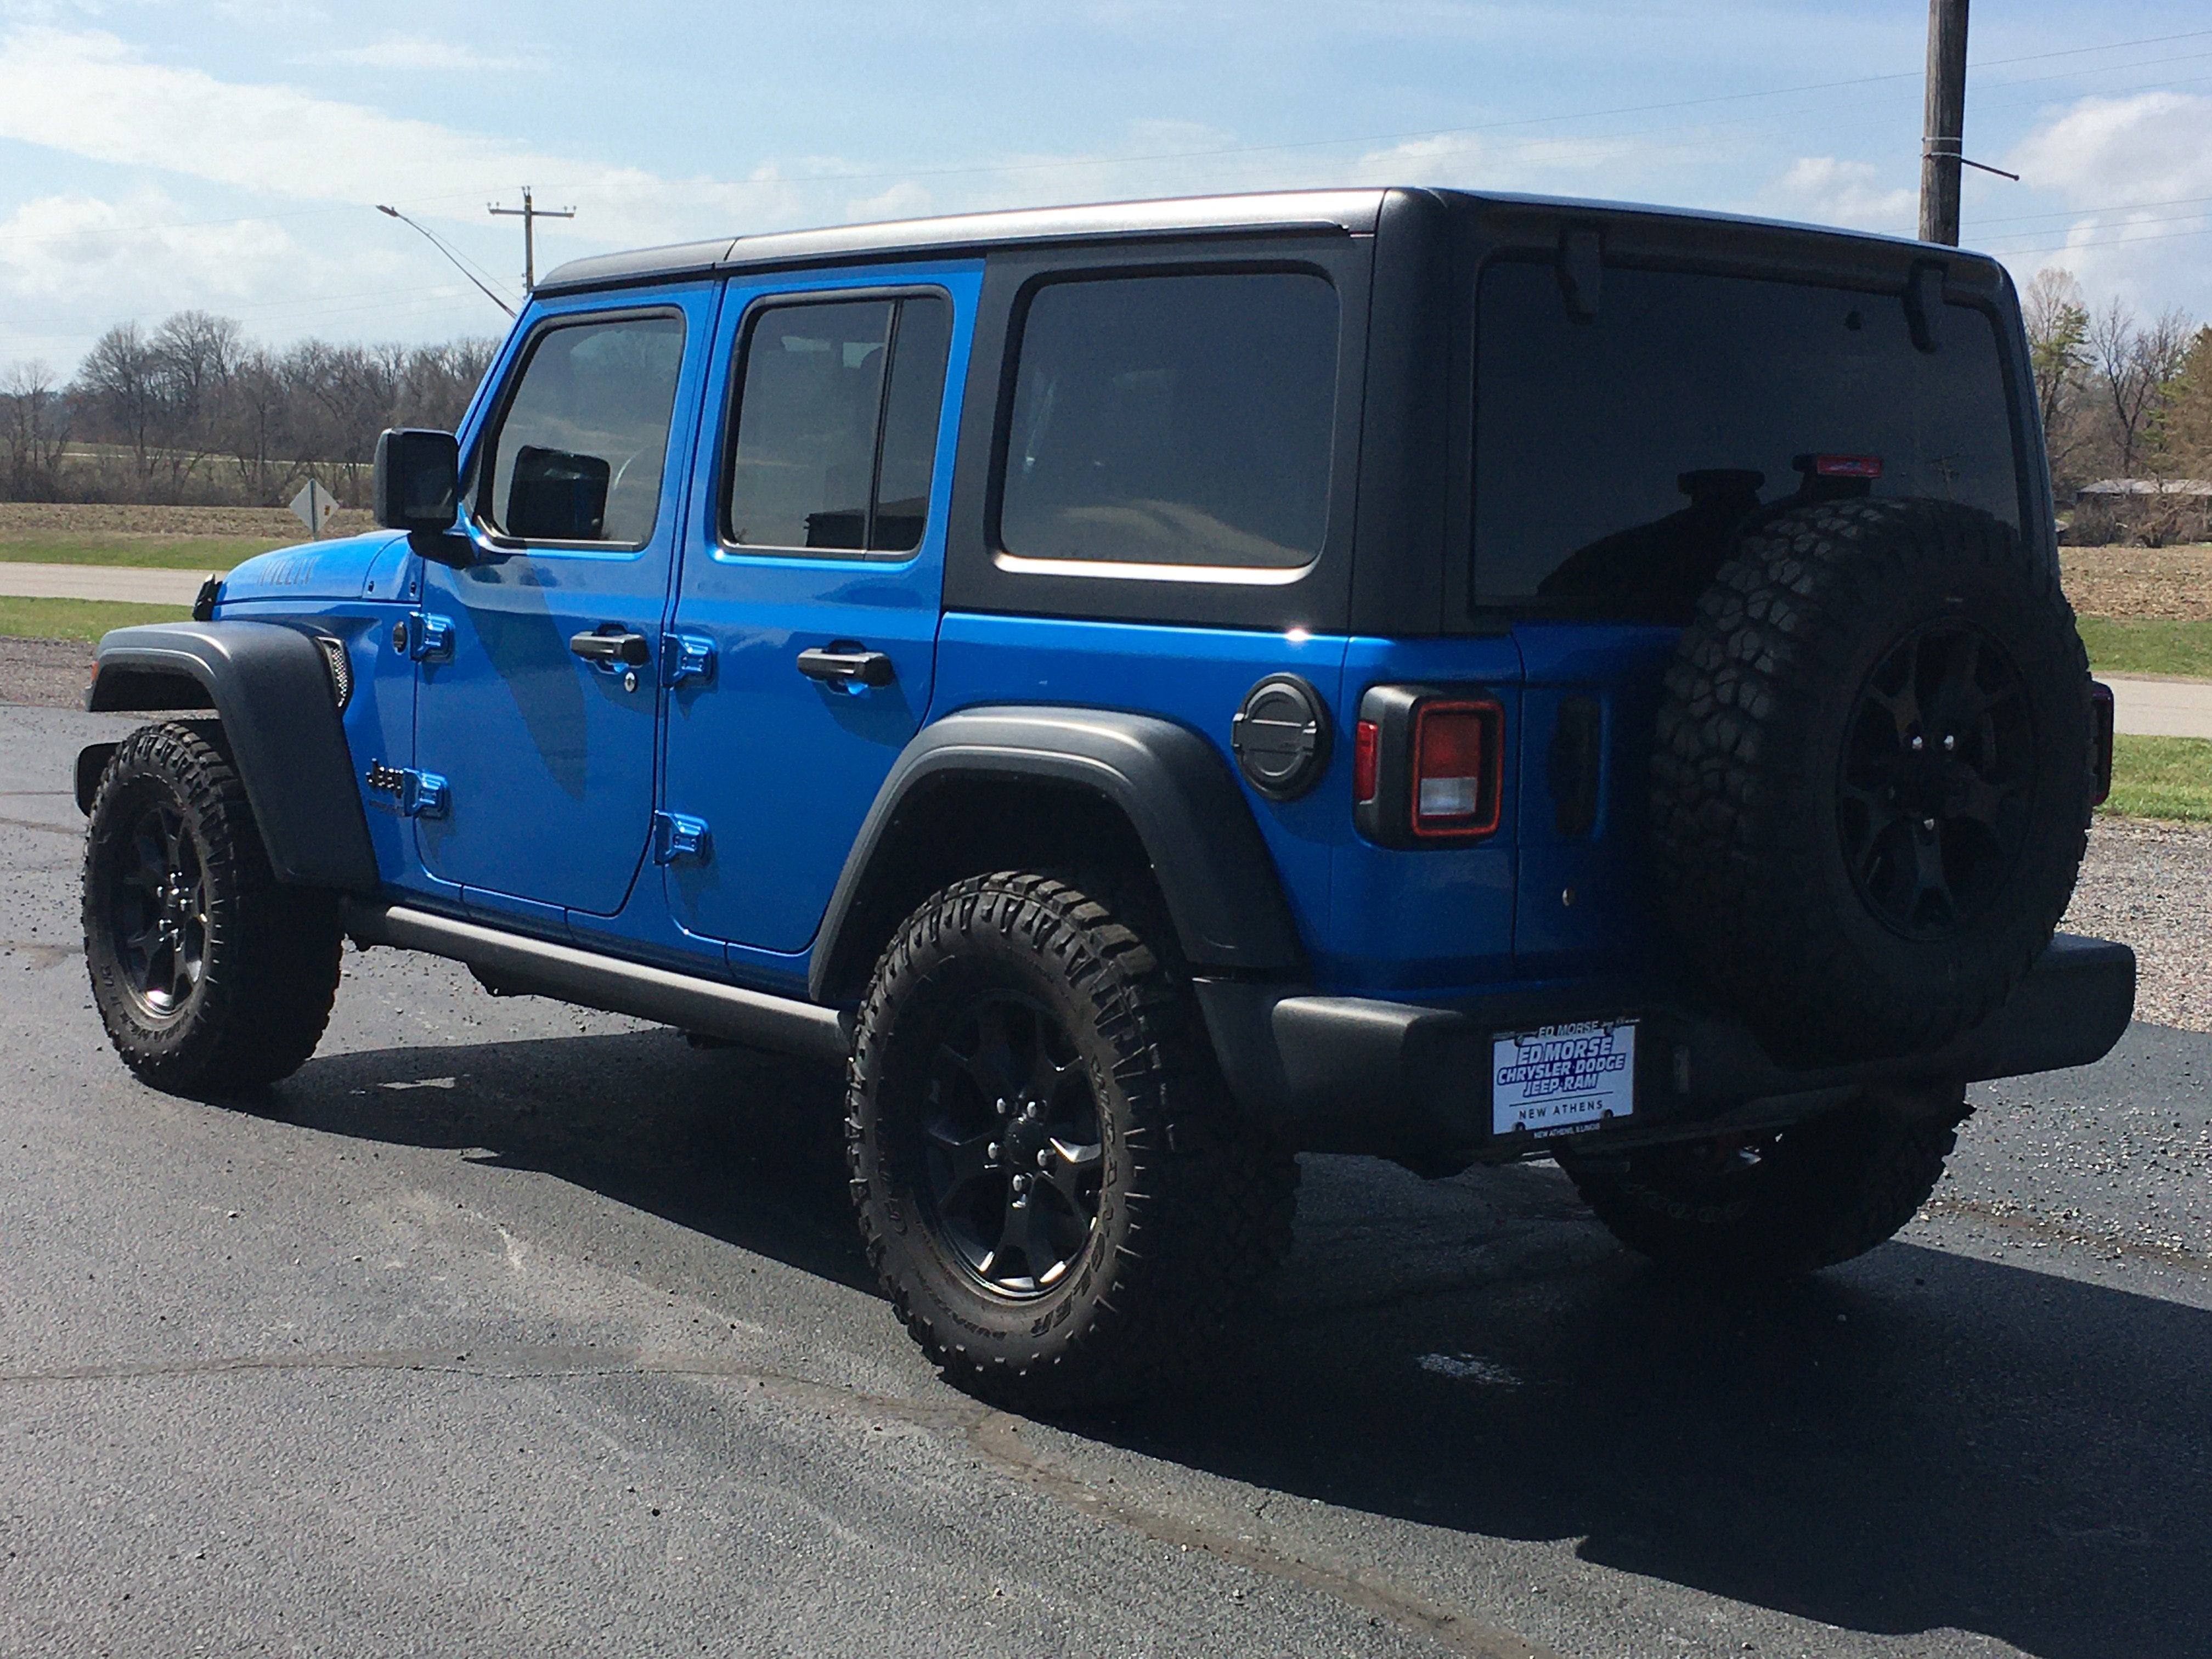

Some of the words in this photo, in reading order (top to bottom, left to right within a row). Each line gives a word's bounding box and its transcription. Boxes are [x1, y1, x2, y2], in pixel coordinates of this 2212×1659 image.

[1538, 1026, 1554, 1038] ED
[1557, 1020, 1599, 1036] MORSE
[1517, 1044, 1543, 1065] ED
[1544, 1037, 1612, 1060] MORSE
[1497, 1062, 1573, 1084] CHRYSLER
[1574, 1054, 1626, 1073] DODGE
[1523, 1078, 1560, 1097] JEEP
[1562, 1075, 1597, 1092] RAM
[1519, 1107, 1547, 1120] NEW
[1553, 1100, 1603, 1115] ATHENS
